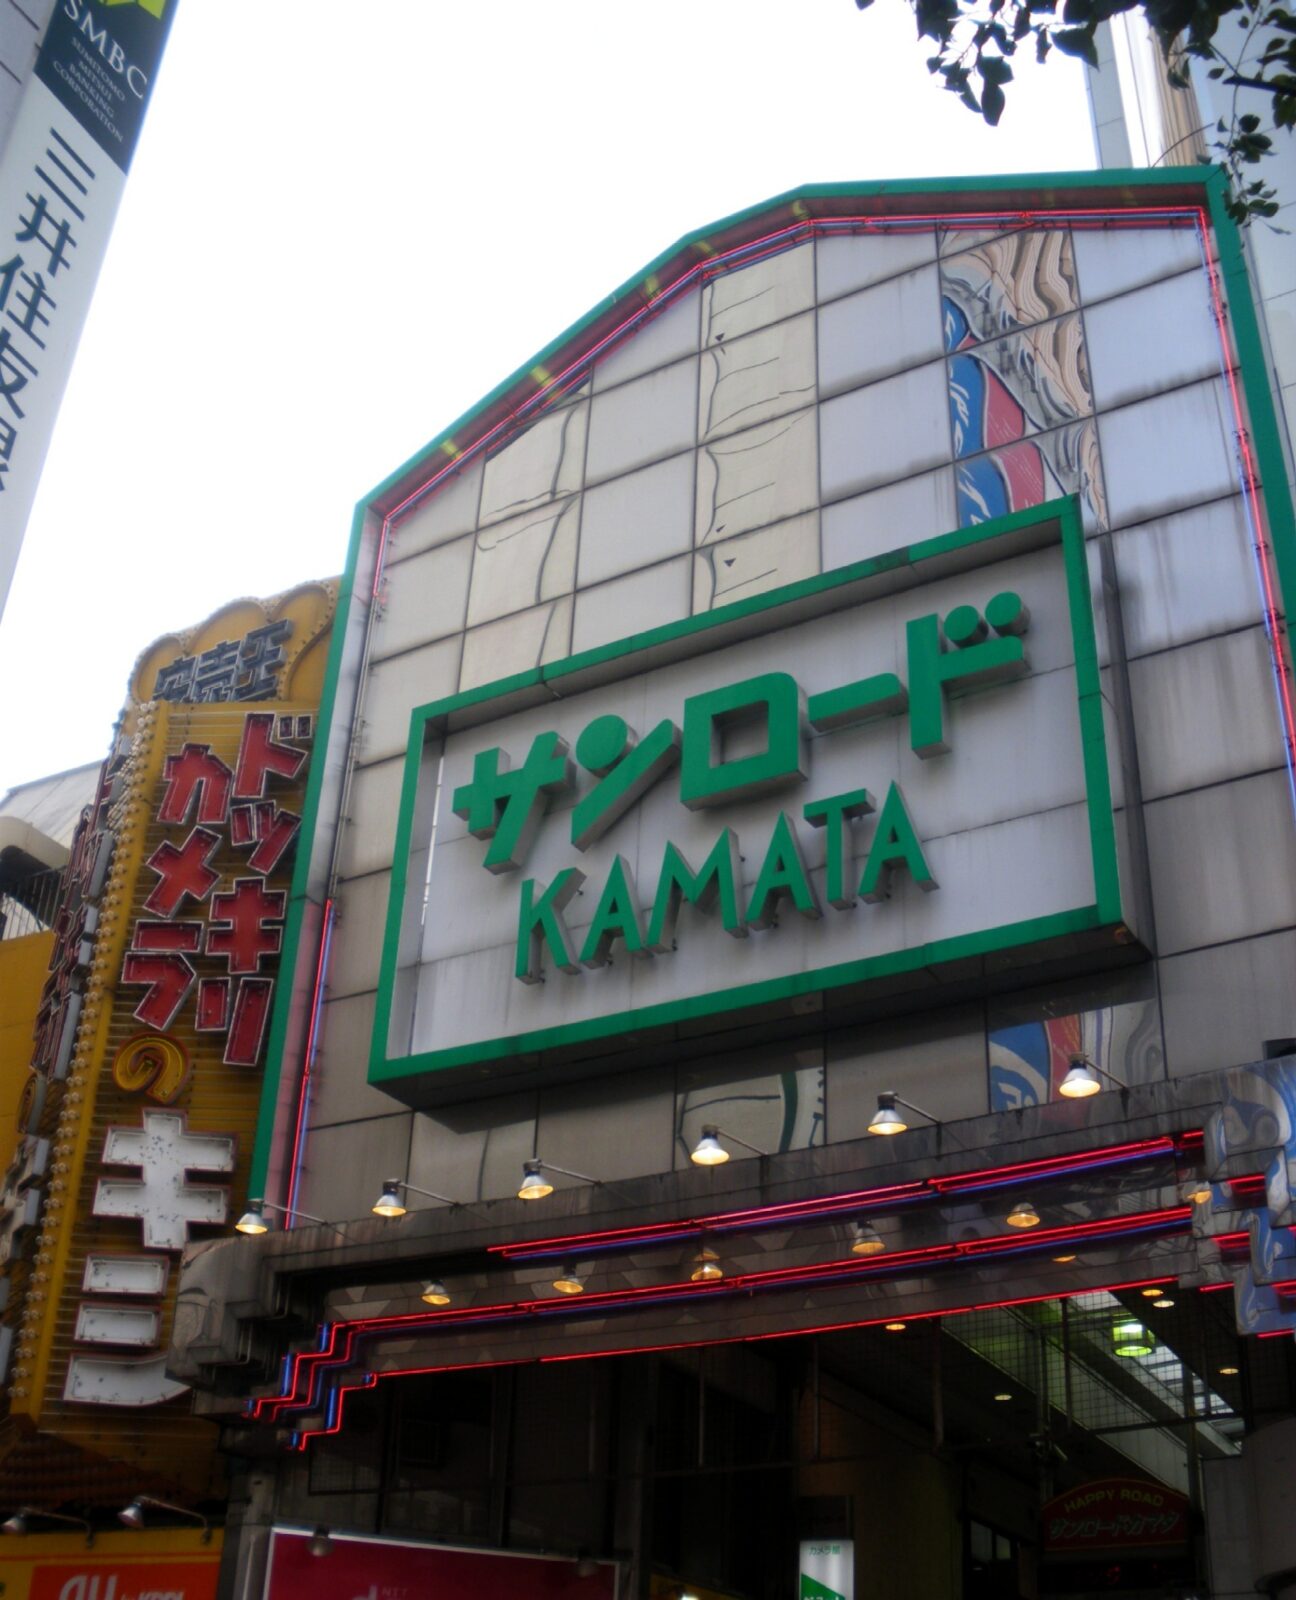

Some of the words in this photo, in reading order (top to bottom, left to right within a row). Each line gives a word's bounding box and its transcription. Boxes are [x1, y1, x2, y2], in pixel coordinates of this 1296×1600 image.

[63, 0, 149, 100] SMBC
[68, 63, 115, 118] BANKING
[70, 36, 126, 102] SUMITOMO
[78, 60, 114, 101] MITSUI
[52, 60, 125, 142] CORPORATION
[452, 592, 1030, 874] サンロード
[194, 711, 312, 1066] ドッキリ
[515, 780, 939, 985] KAMATA
[1063, 1489, 1114, 1512] HAPPY
[1120, 1489, 1164, 1507] ROAD
